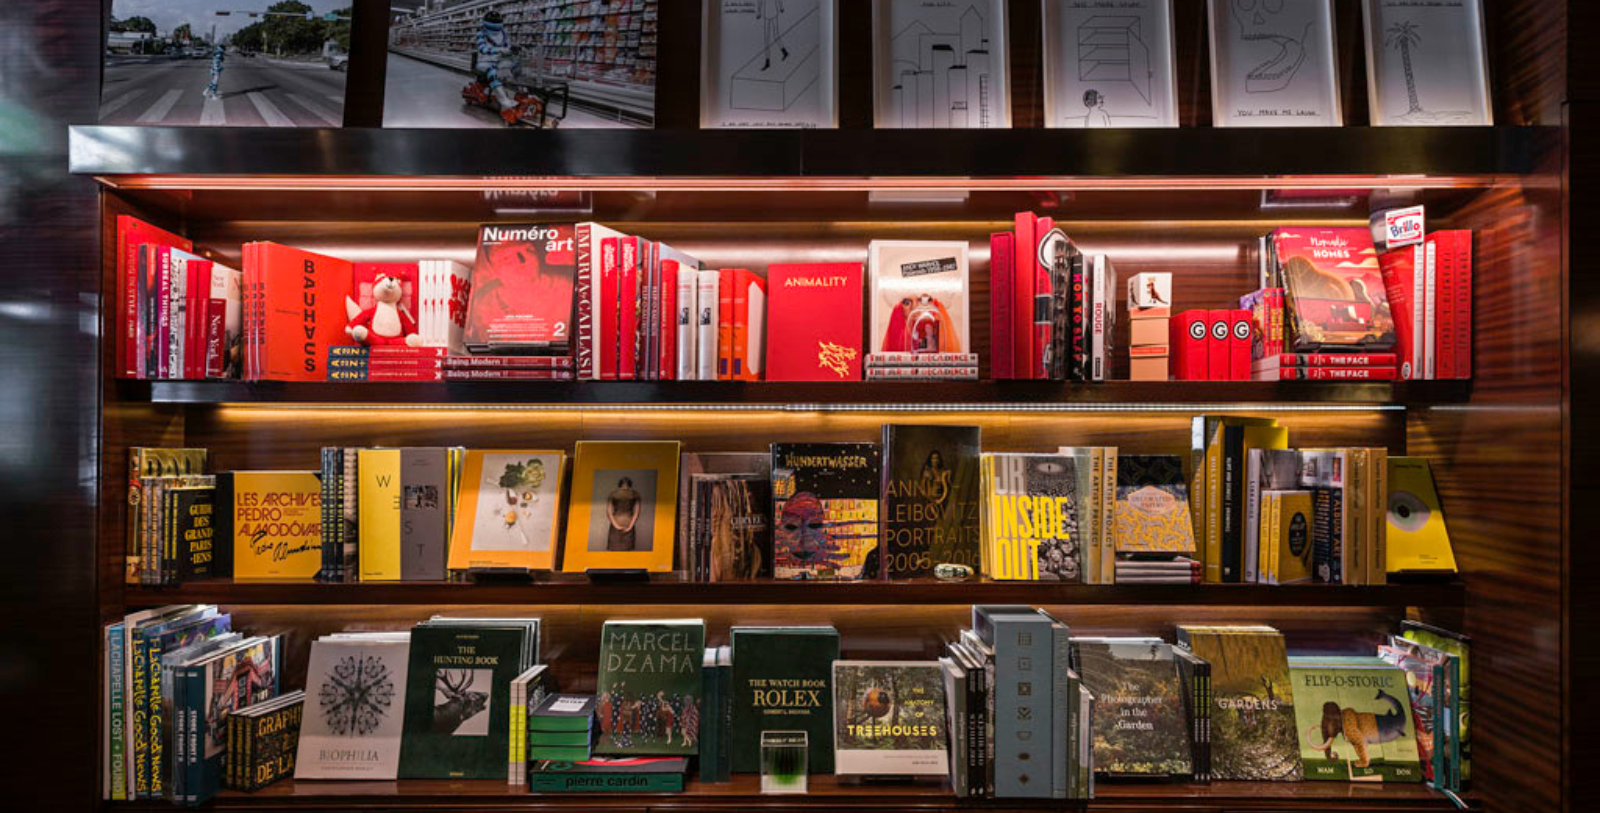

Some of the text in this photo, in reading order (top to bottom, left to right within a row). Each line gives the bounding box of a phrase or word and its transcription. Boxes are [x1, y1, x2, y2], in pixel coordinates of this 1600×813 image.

[1237, 109, 1253, 117] YOU
[482, 226, 559, 242] Numéro
[1389, 221, 1421, 239] Brillo
[544, 239, 574, 252] art
[577, 232, 591, 292] MARIA
[784, 276, 847, 287] ANIMALITY
[161, 253, 170, 327] SURREAL THINGS
[303, 260, 315, 373] BAUHAUS
[1073, 304, 1082, 326] TO
[1094, 302, 1103, 335] ROUGE
[210, 315, 221, 359] New York
[553, 322, 565, 337] 2
[579, 299, 592, 369] CALLAS
[447, 357, 501, 368] Being Modern
[1330, 356, 1370, 364] THE FACE
[447, 370, 501, 380] Being Modern
[1330, 370, 1370, 378] THE FACE
[785, 452, 868, 469] HUNDERTWASSER
[994, 456, 1025, 495] JR
[237, 492, 258, 507] LES
[1106, 456, 1115, 549] THE ARTIST PROJECT
[188, 504, 213, 516] GUIDE
[237, 507, 282, 521] PEDRO
[886, 503, 977, 523] LEIBOVITZ
[995, 495, 1069, 540] INSIDE
[193, 516, 210, 528] DES
[184, 528, 213, 541] GRAND
[189, 541, 212, 553] PARIS
[996, 538, 1041, 581] OUT
[609, 632, 695, 652] MARCEL
[457, 646, 476, 655] THE
[433, 655, 499, 665] HUNTING BOOK
[607, 653, 694, 673] DZAMA
[111, 637, 122, 709] LACHAPELLE
[748, 679, 826, 688] THE WATCH BOOK
[1122, 682, 1140, 692] The
[1304, 674, 1394, 688] FLIP-O-STORIC
[752, 690, 822, 707] ROLEX
[1100, 693, 1163, 707] Photographer
[1218, 699, 1278, 710] GARDENS
[1120, 707, 1148, 717] in the
[112, 712, 122, 742] LOST
[134, 711, 147, 753] Good
[847, 725, 937, 737] TREEHOUSES
[1118, 719, 1154, 731] Garden
[150, 714, 162, 756] Good
[319, 749, 379, 762] BIOPHILIA
[112, 754, 122, 792] FOUND
[256, 758, 275, 784] DE
[565, 775, 648, 788] pierre cardin
